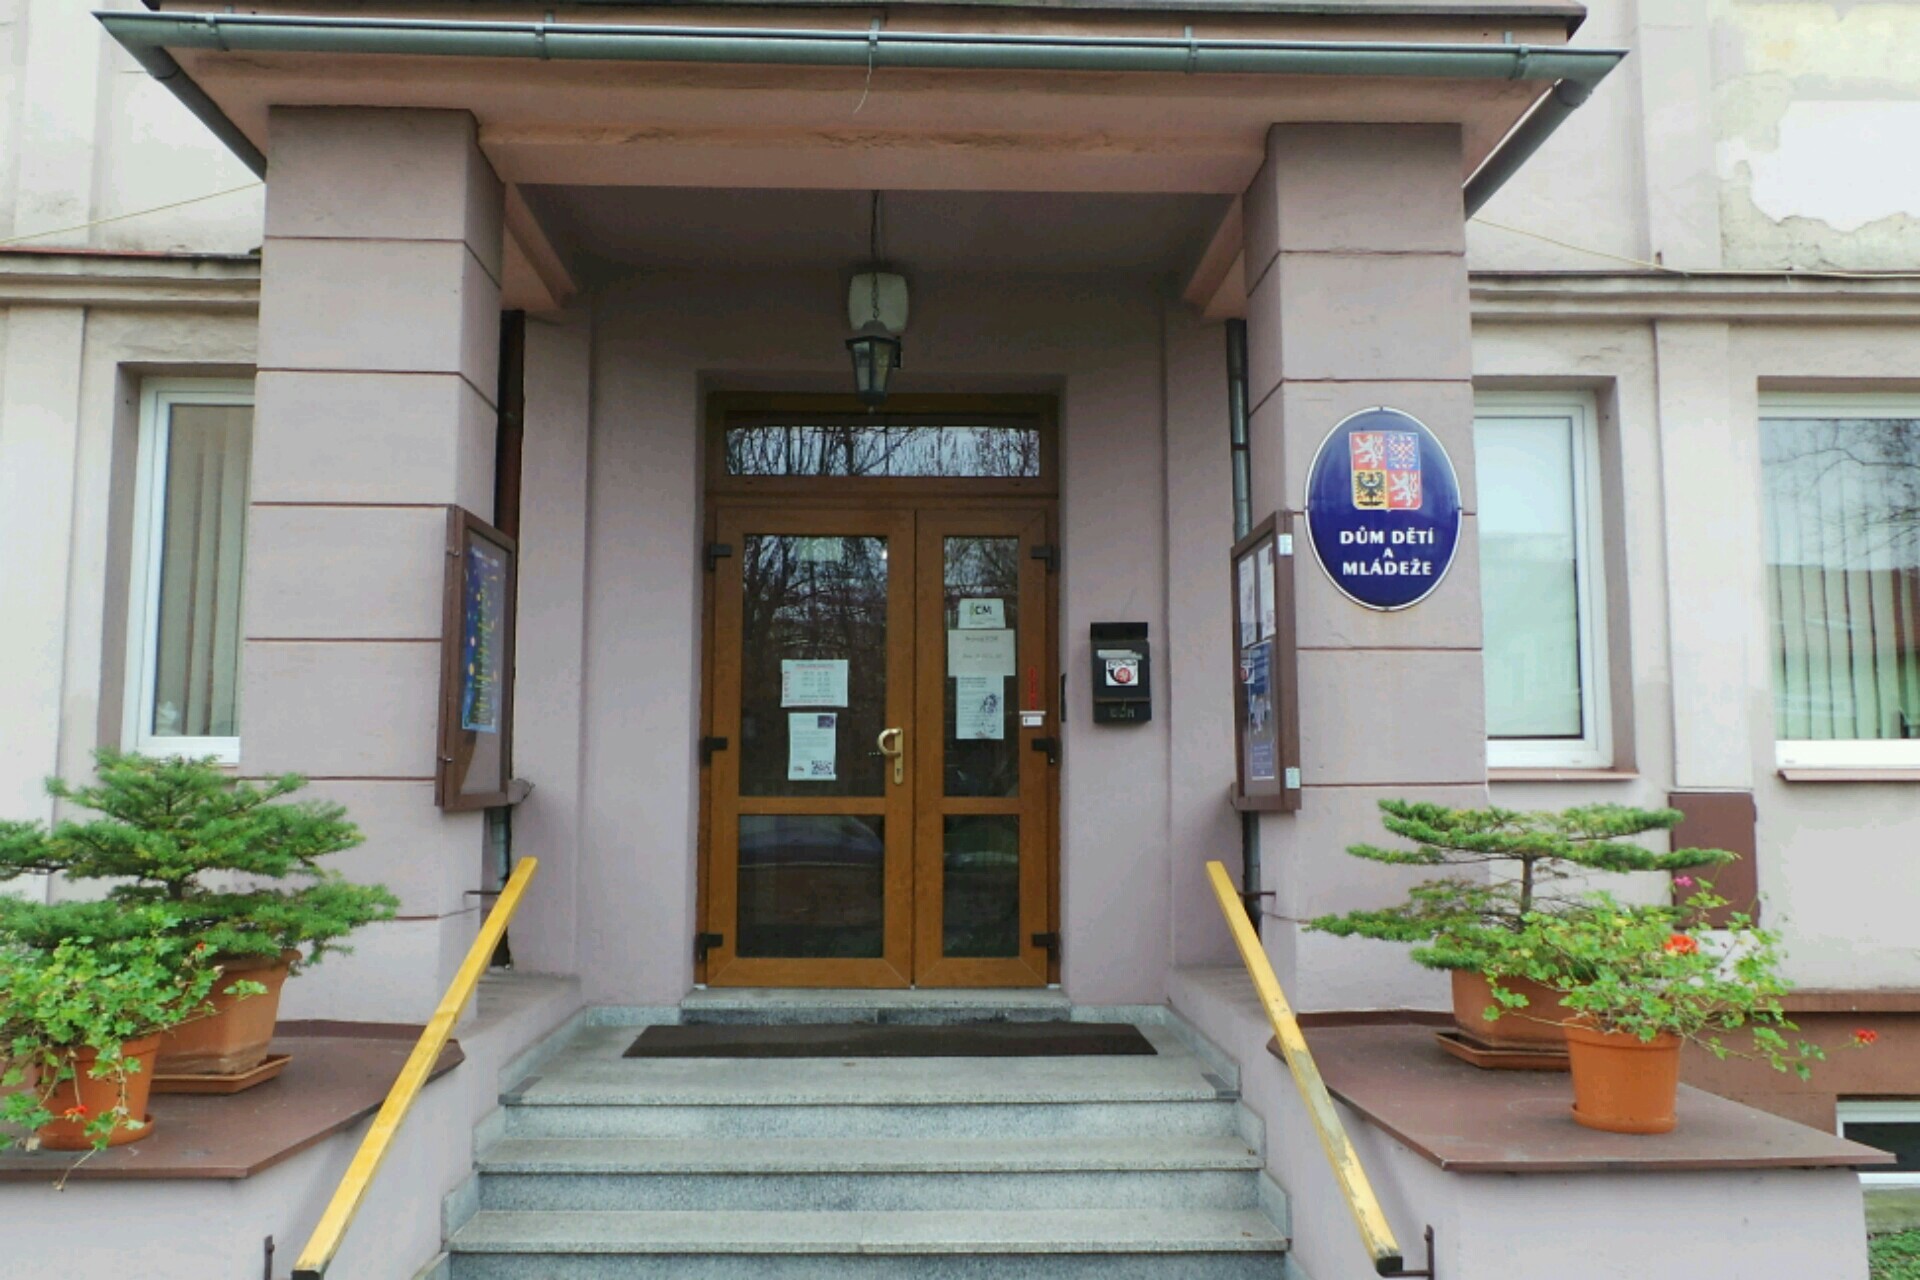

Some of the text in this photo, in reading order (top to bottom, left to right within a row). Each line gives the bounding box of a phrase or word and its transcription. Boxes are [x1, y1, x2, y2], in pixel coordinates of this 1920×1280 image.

[1340, 526, 1434, 544] DŮM DĚTÍ
[1383, 547, 1394, 558] A
[1342, 558, 1432, 576] MLÁDEŽE
